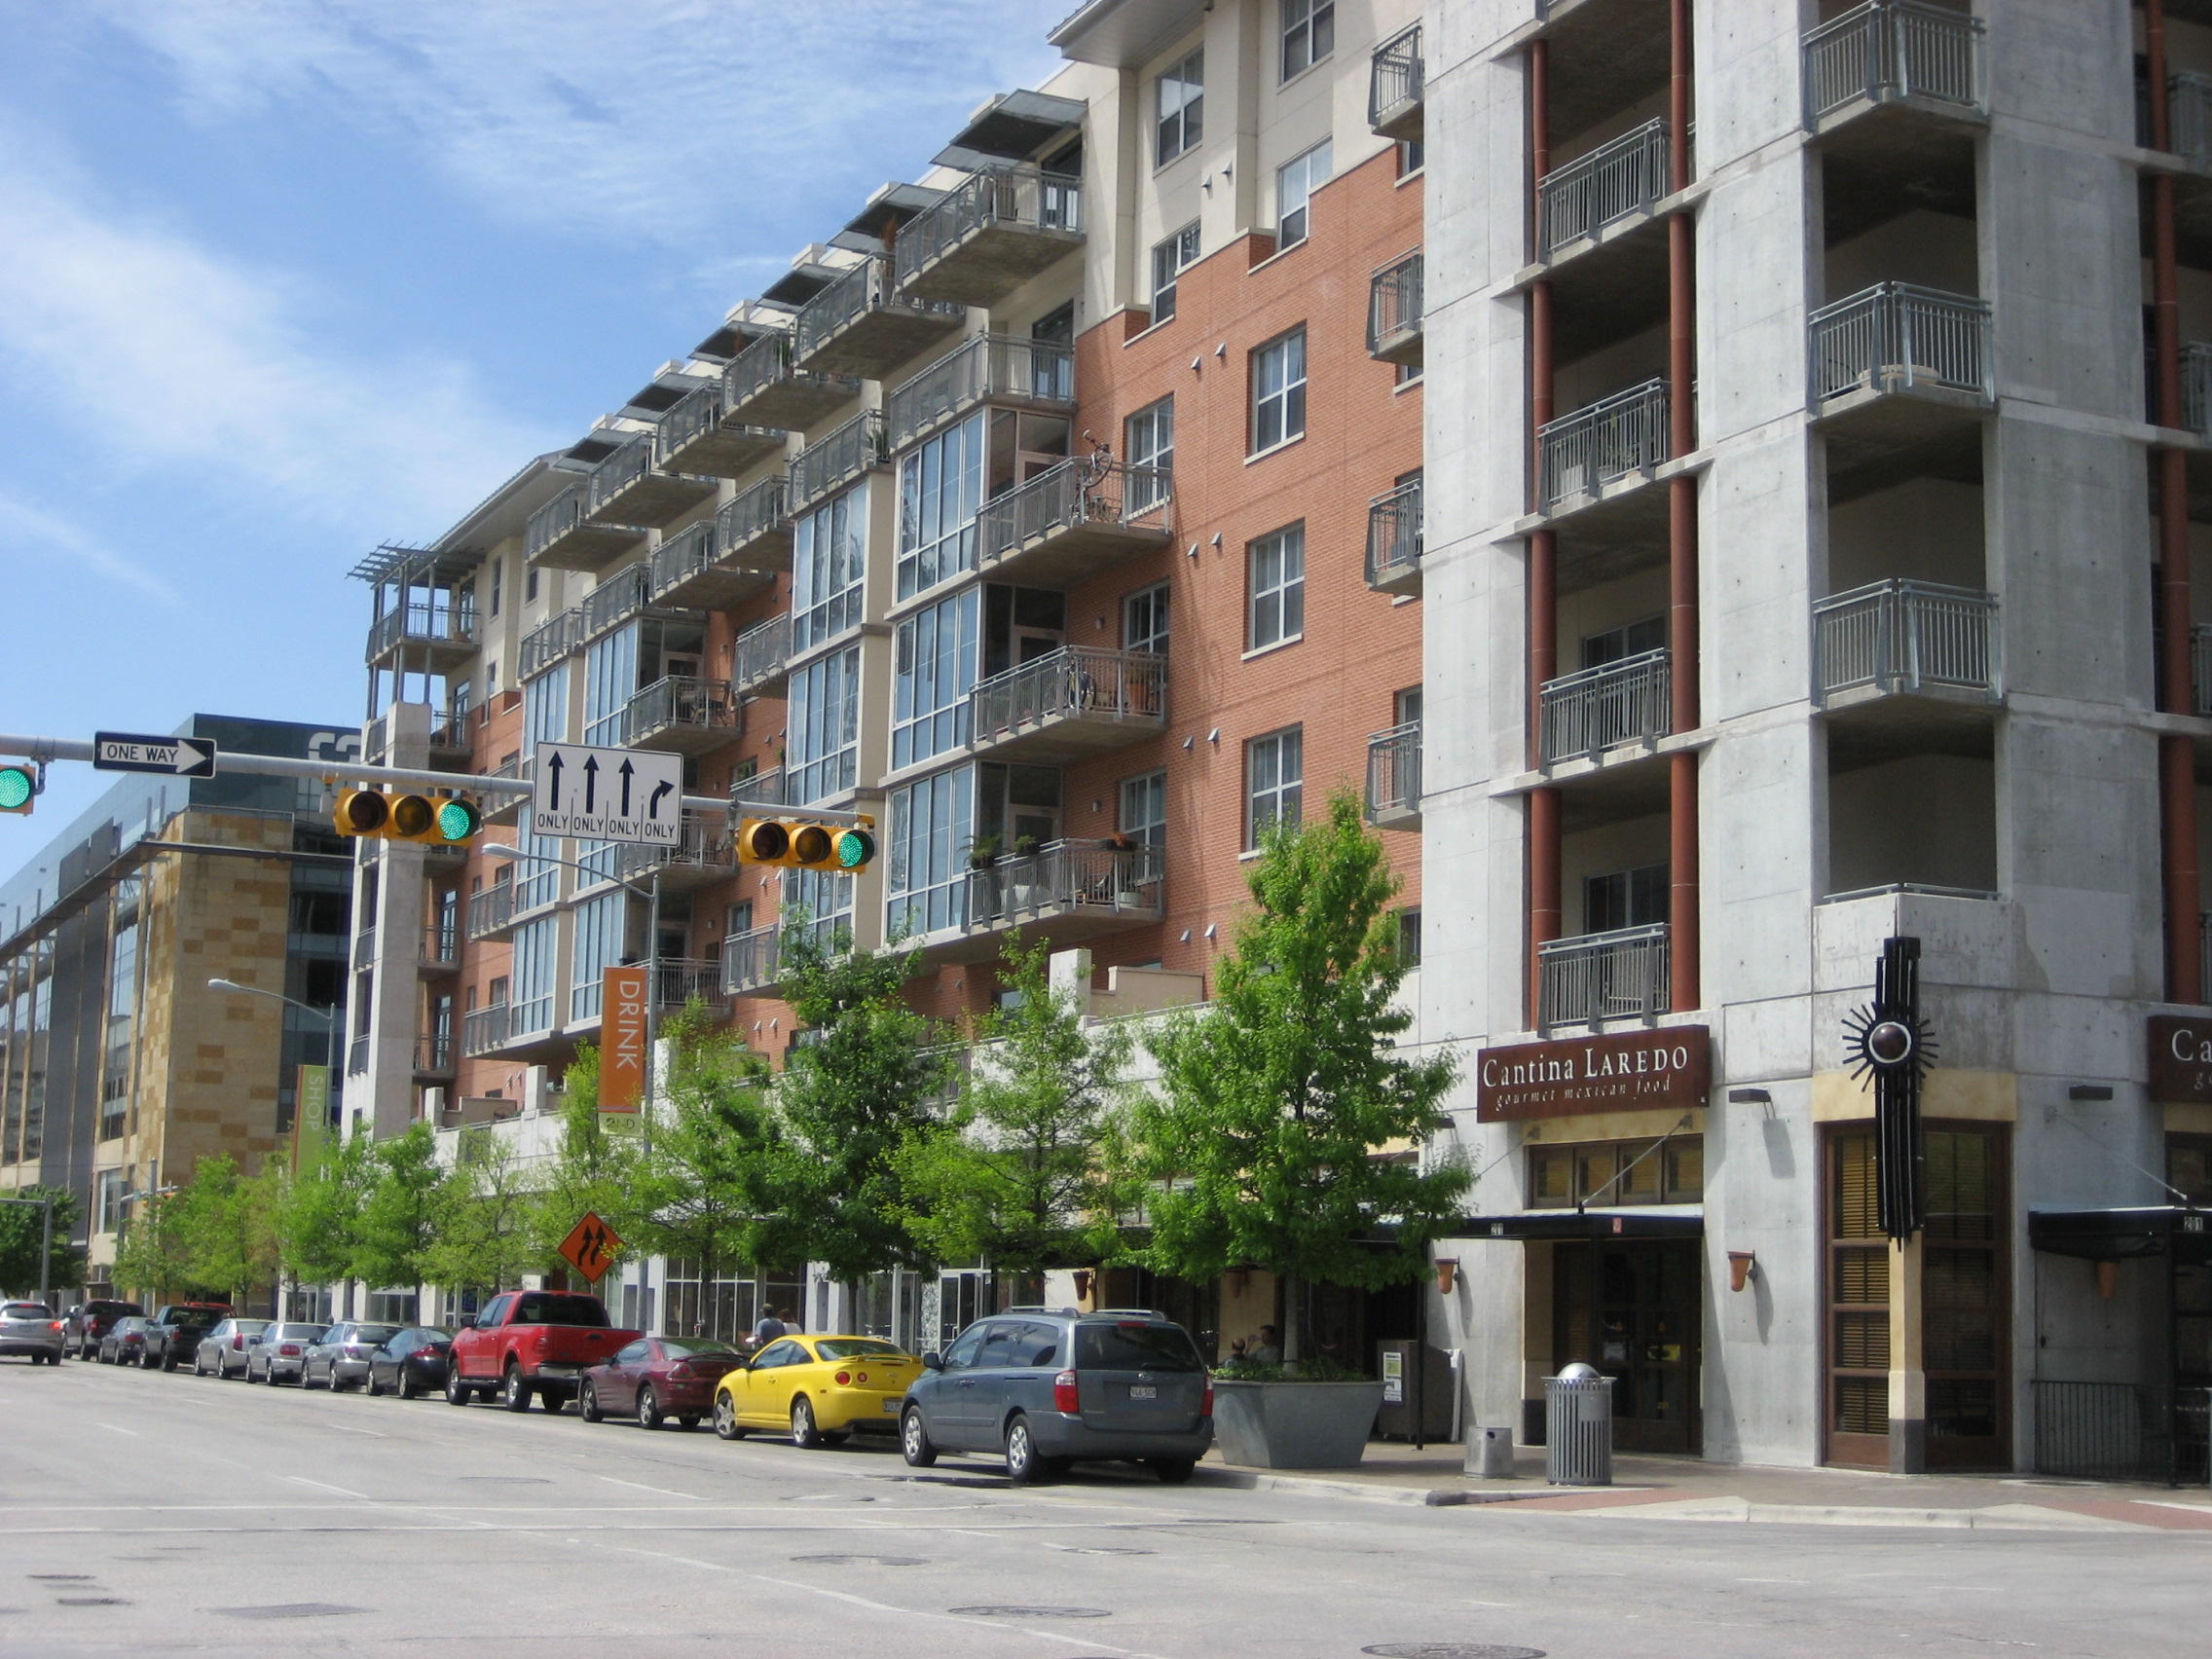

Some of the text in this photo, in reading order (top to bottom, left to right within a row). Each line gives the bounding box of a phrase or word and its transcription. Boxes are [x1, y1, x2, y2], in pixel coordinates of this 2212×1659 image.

[107, 744, 178, 763] ONE WAY
[537, 813, 676, 838] ONLY ONLY ONLY ONLY
[616, 980, 641, 1069] DRINK
[1483, 1045, 1688, 1088] Cantina LAREDO
[305, 1074, 324, 1131] SHOP
[1495, 1073, 1670, 1112] gourmet mexican food
